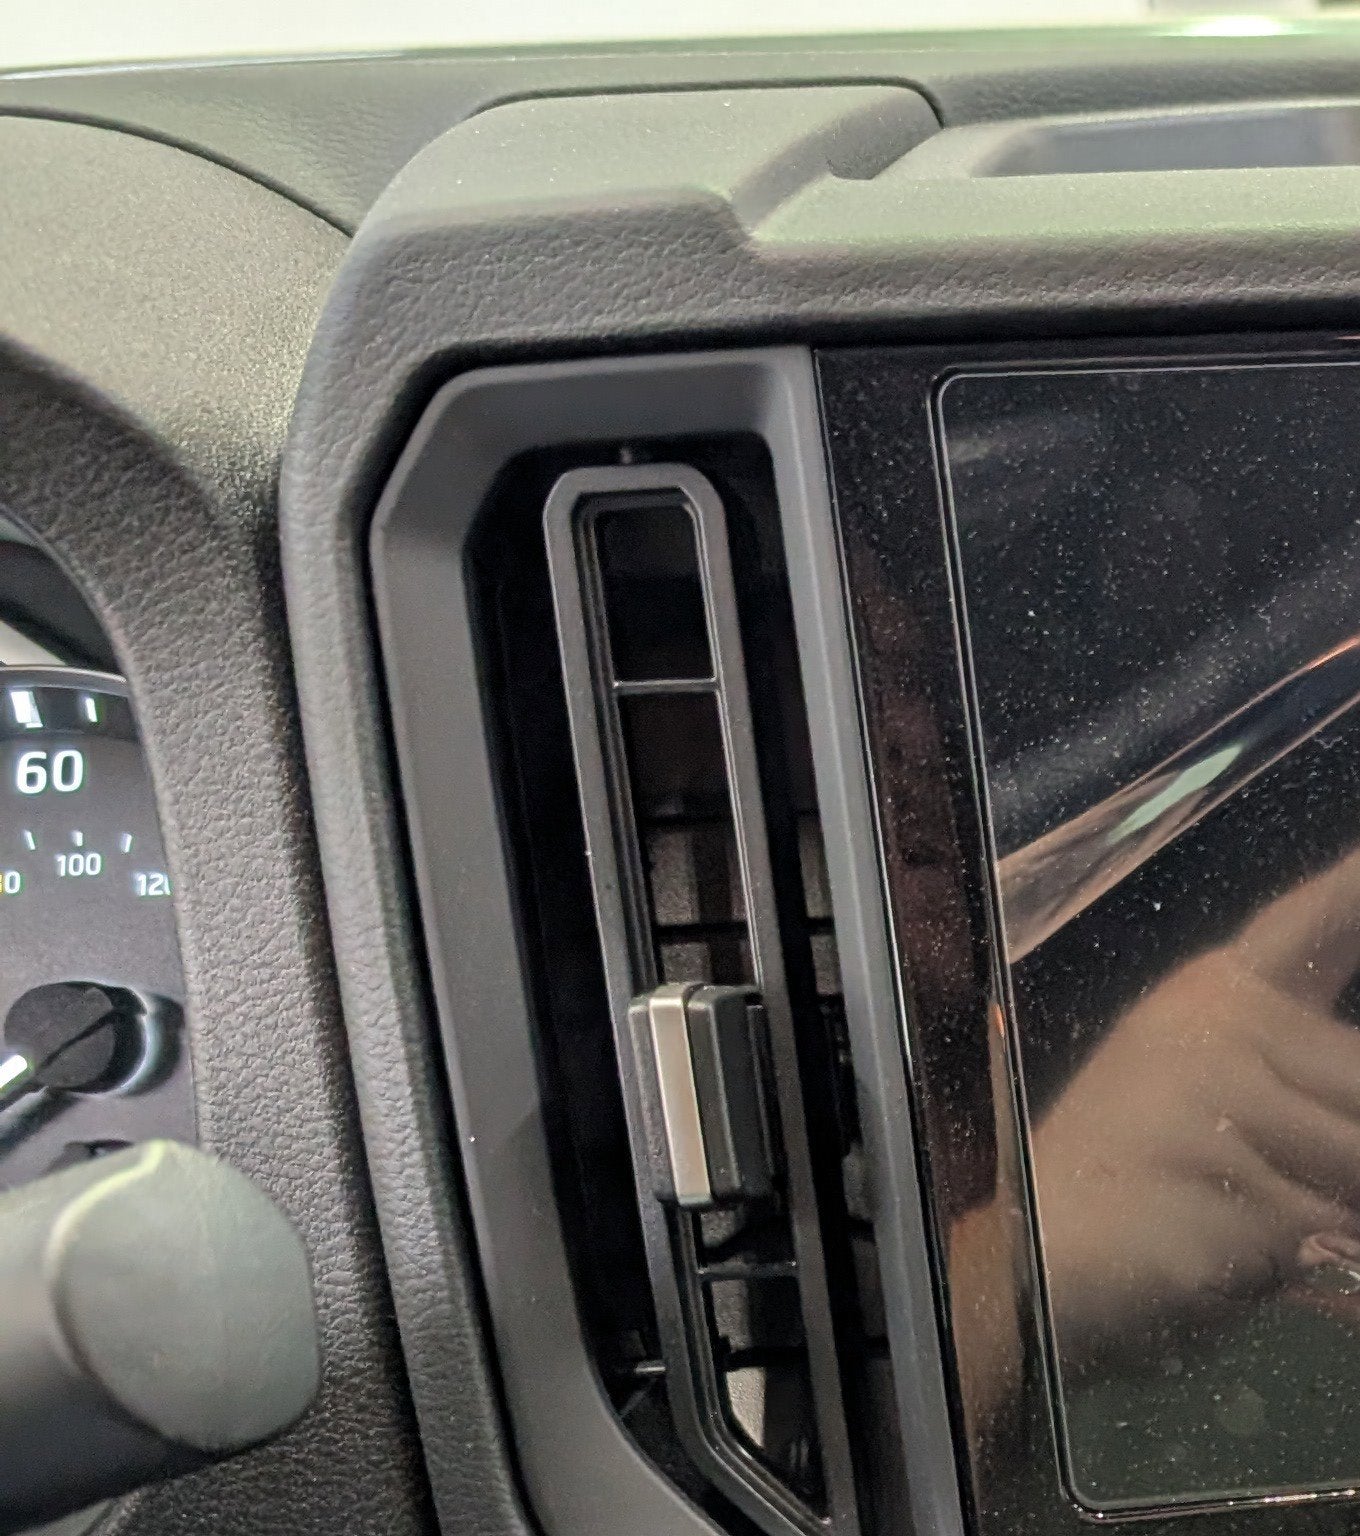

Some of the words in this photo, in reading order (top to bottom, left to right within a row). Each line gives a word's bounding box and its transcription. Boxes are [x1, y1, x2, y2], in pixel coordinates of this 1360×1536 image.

[17, 750, 84, 794] 60
[57, 853, 102, 877] 100
[0, 871, 21, 894] 0
